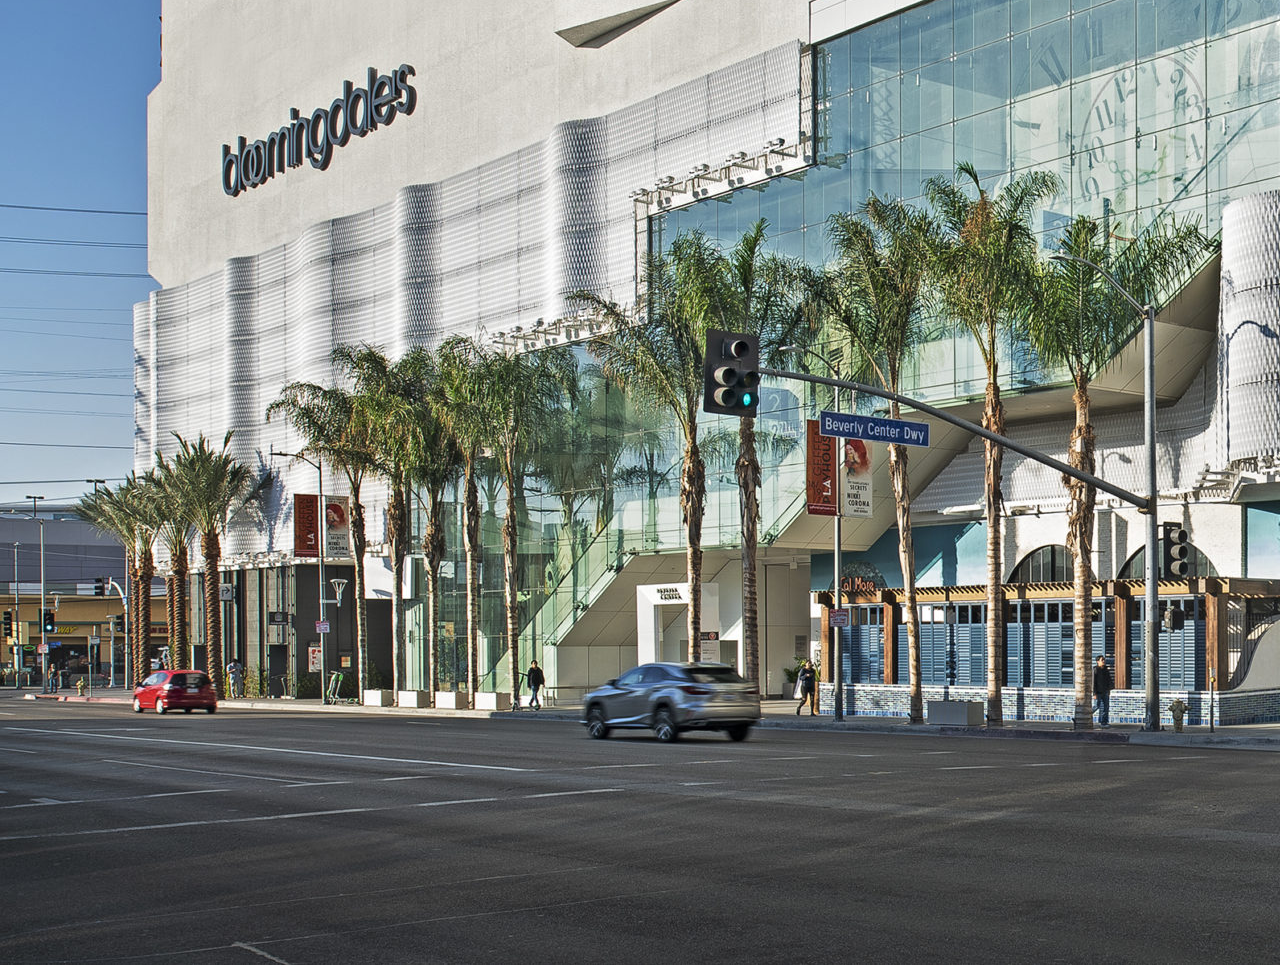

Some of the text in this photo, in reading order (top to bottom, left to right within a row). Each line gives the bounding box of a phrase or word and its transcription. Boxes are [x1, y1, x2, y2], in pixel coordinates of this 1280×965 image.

[825, 417, 925, 443] Beverly Center Dwy
[822, 436, 832, 504] PLAYHOUS
[848, 499, 870, 507] CORONA
